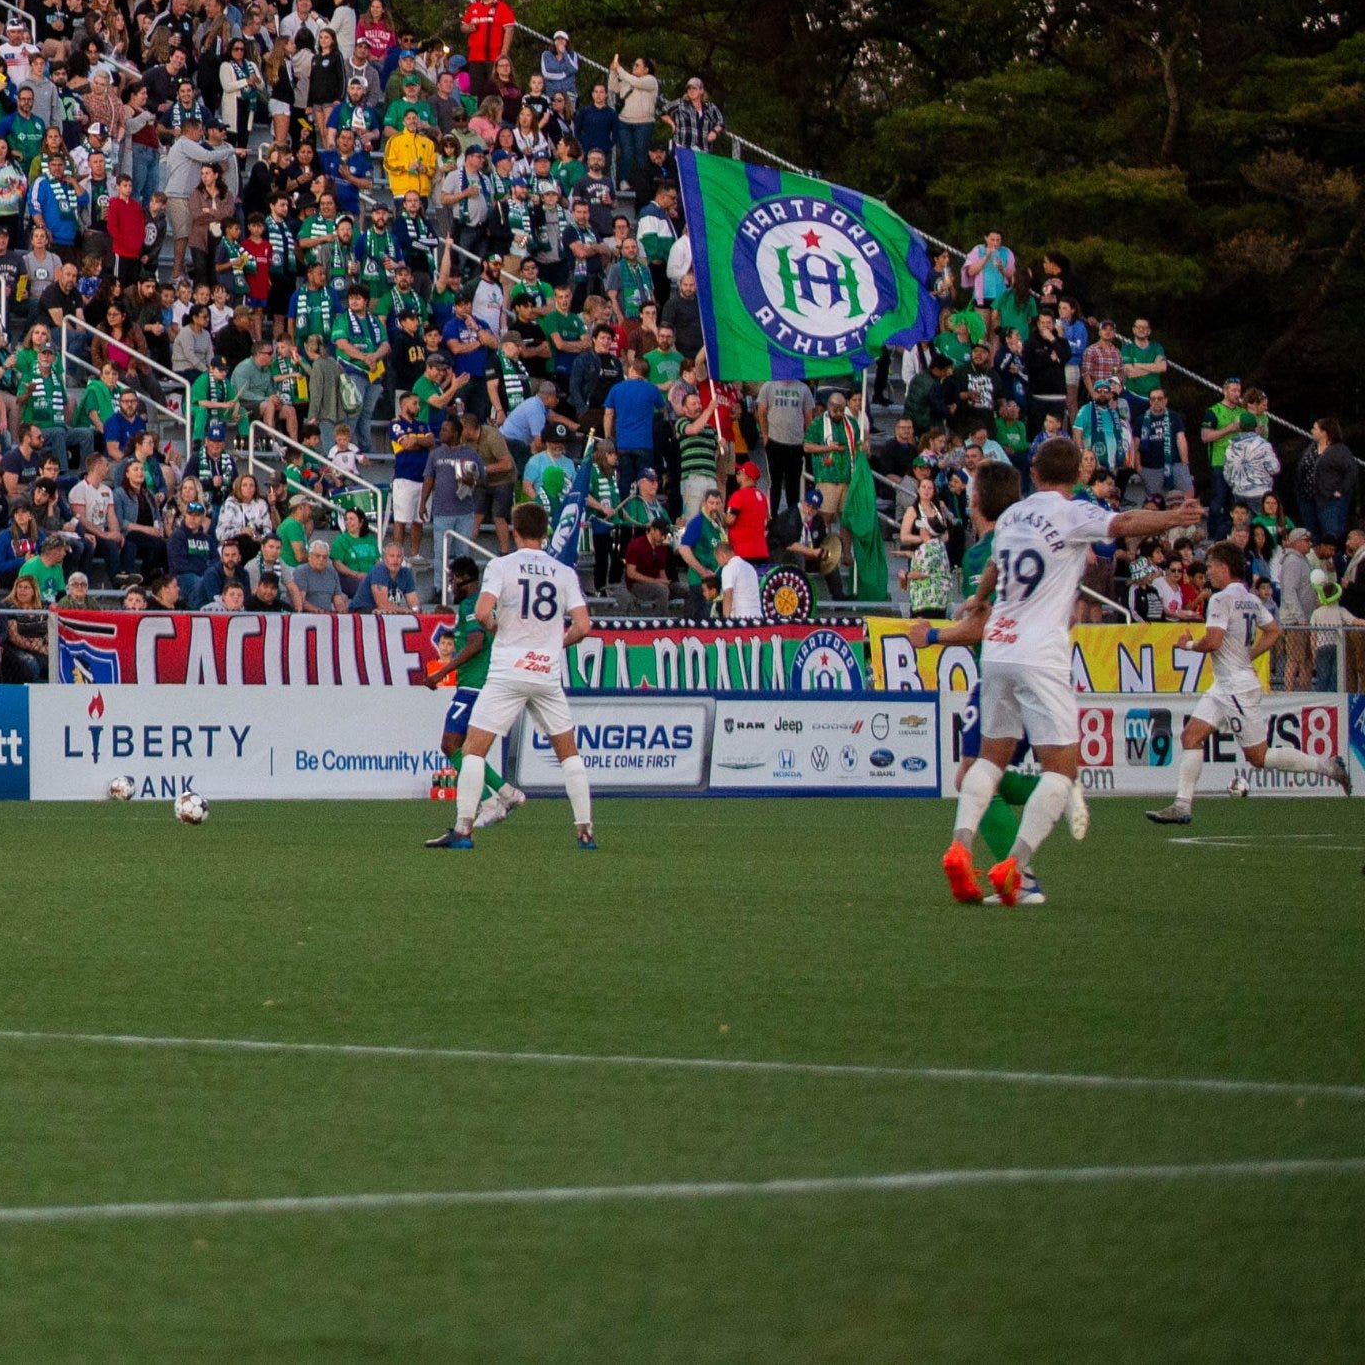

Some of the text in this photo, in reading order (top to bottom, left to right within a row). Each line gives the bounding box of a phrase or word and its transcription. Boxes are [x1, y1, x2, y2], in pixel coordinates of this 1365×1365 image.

[740, 199, 881, 261] HARTFORD
[519, 563, 557, 578] KELLY
[998, 548, 1045, 602] 19
[517, 578, 559, 622] 18
[523, 661, 552, 675] Zone
[524, 650, 550, 663] Auto
[532, 723, 694, 751] GNGRAS
[736, 721, 766, 730] RAM
[774, 716, 804, 735] Jeep
[1080, 707, 1108, 766] 8
[1125, 718, 1155, 742] my
[63, 724, 252, 763] LIBERTY
[1126, 734, 1171, 767] TV 9
[295, 750, 319, 771] Be
[321, 748, 419, 776] Community
[614, 754, 643, 769] COME
[645, 754, 677, 769] FIRST
[772, 770, 803, 779] HONDA
